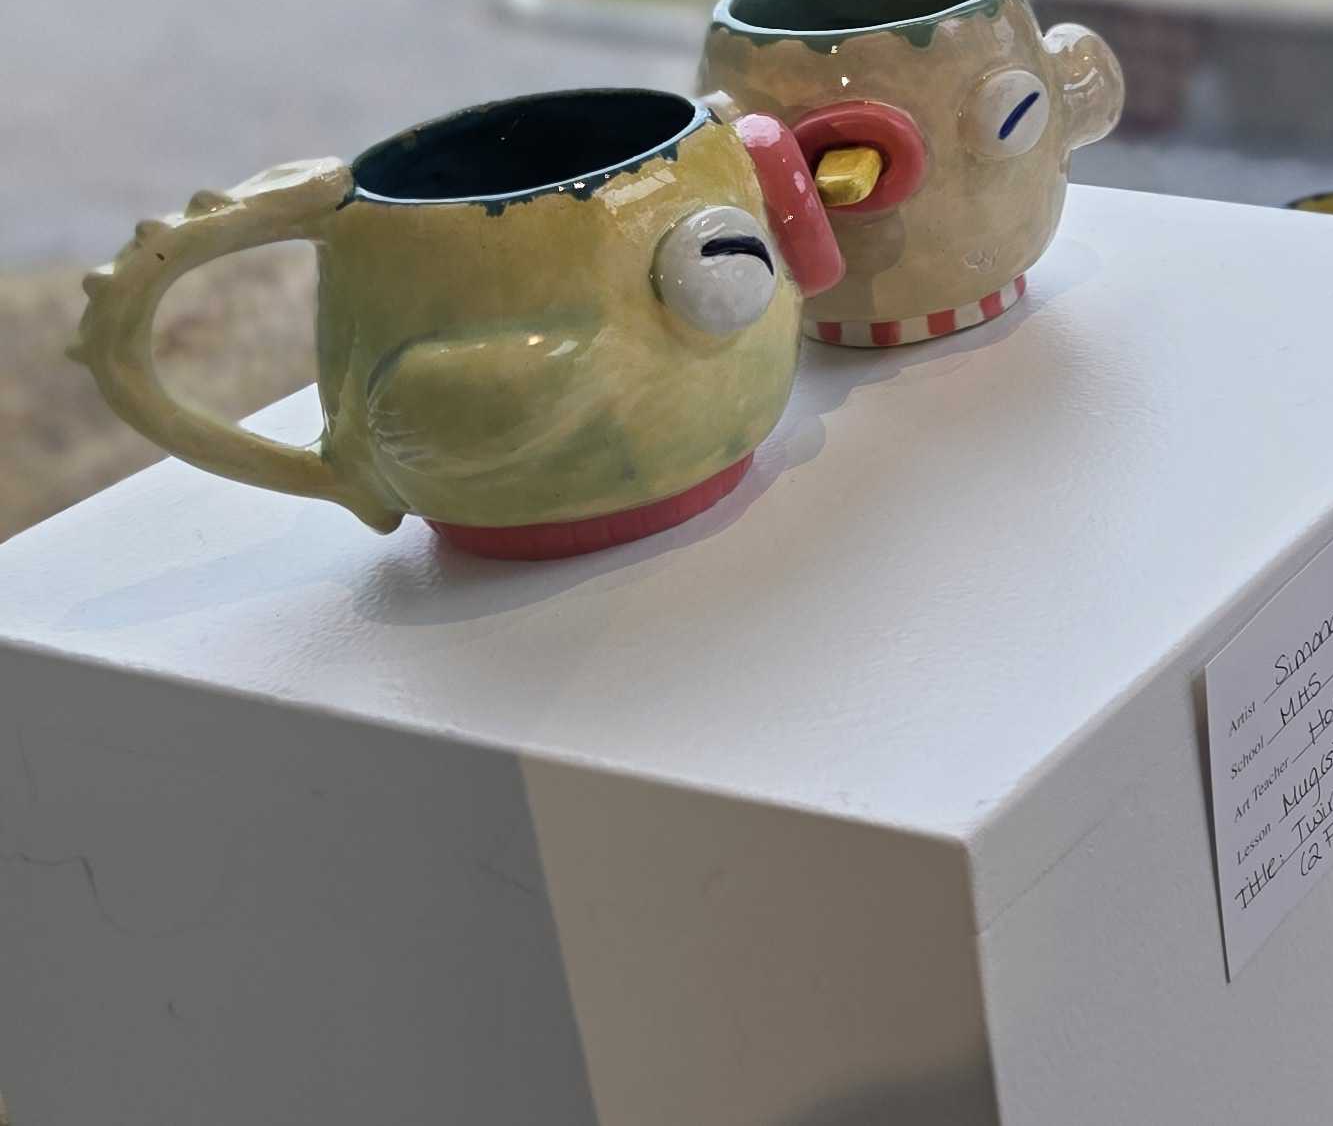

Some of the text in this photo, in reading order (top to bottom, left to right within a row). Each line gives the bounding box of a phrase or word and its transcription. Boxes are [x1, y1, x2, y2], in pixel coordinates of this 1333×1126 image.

[1229, 702, 1256, 736] Artist
[1231, 736, 1264, 779] School
[1280, 673, 1321, 725] MHS
[1235, 801, 1250, 822] Art
[1252, 757, 1289, 798] Teacher
[1237, 823, 1272, 865] Lesson
[1300, 843, 1323, 876] (2
